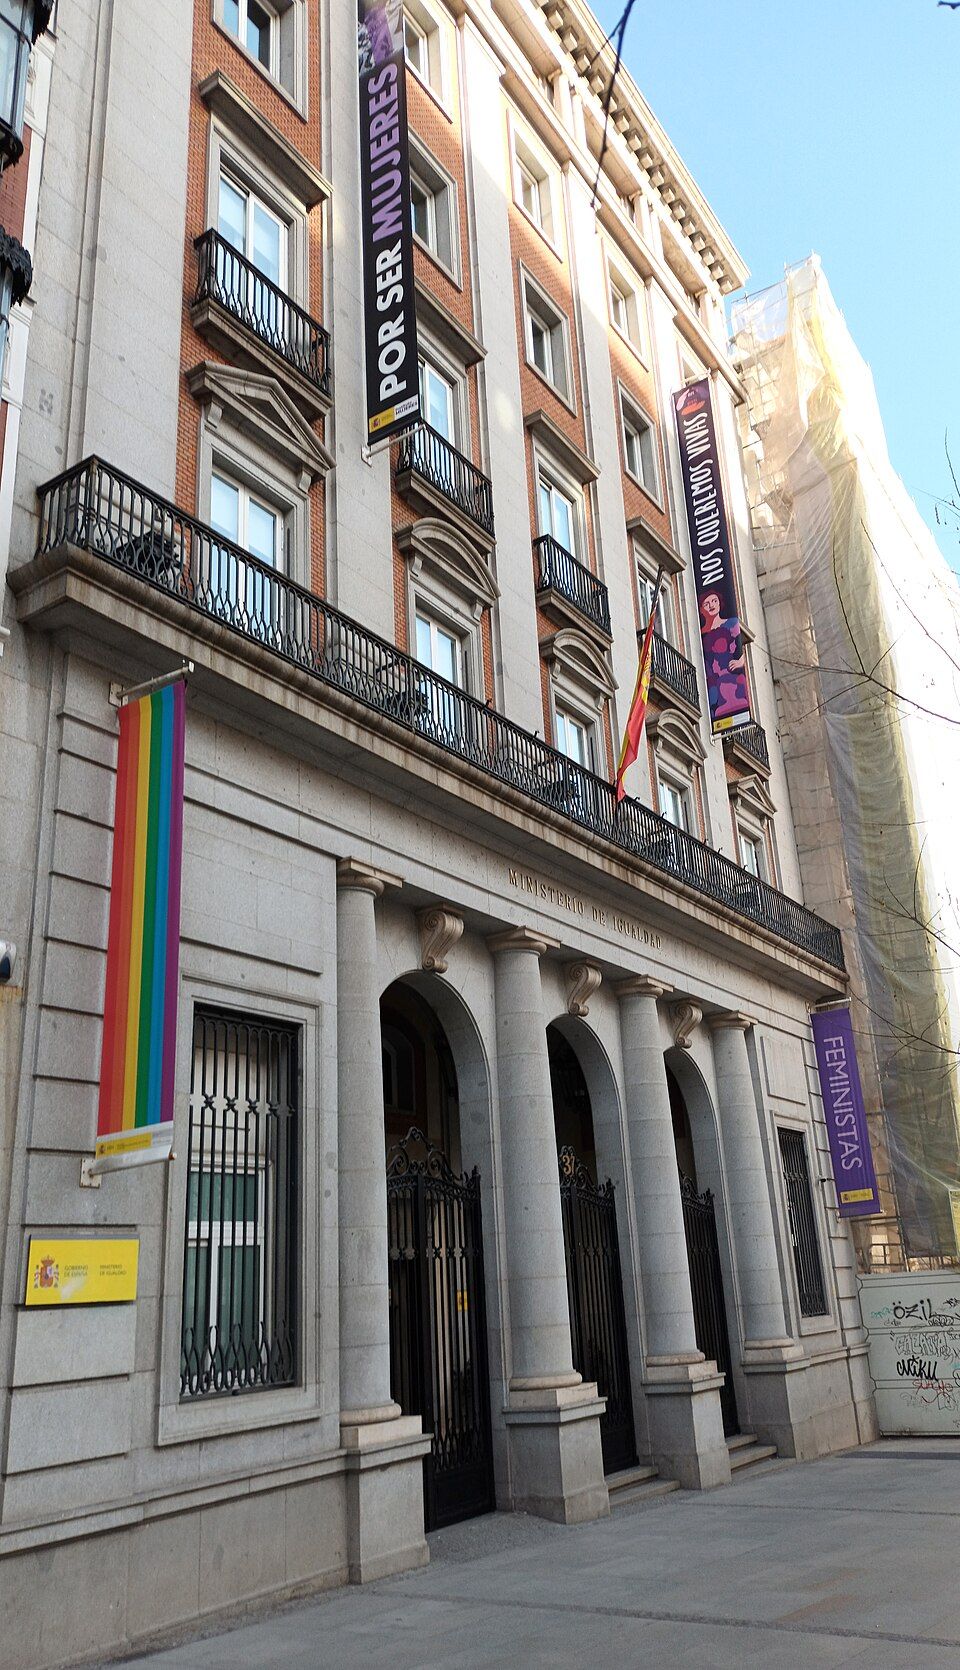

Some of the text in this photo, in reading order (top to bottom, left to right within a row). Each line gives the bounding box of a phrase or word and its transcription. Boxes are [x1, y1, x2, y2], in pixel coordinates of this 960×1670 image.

[368, 63, 404, 243] MUJERES
[376, 238, 405, 311] SER
[377, 310, 407, 402] POR
[683, 411, 712, 461] VIVAS
[688, 458, 720, 547] QUEREMOS
[699, 547, 725, 587] NOS
[507, 868, 663, 949] MINISTERIO DE IGUALDAD
[823, 1035, 862, 1171] FEMINISTAS
